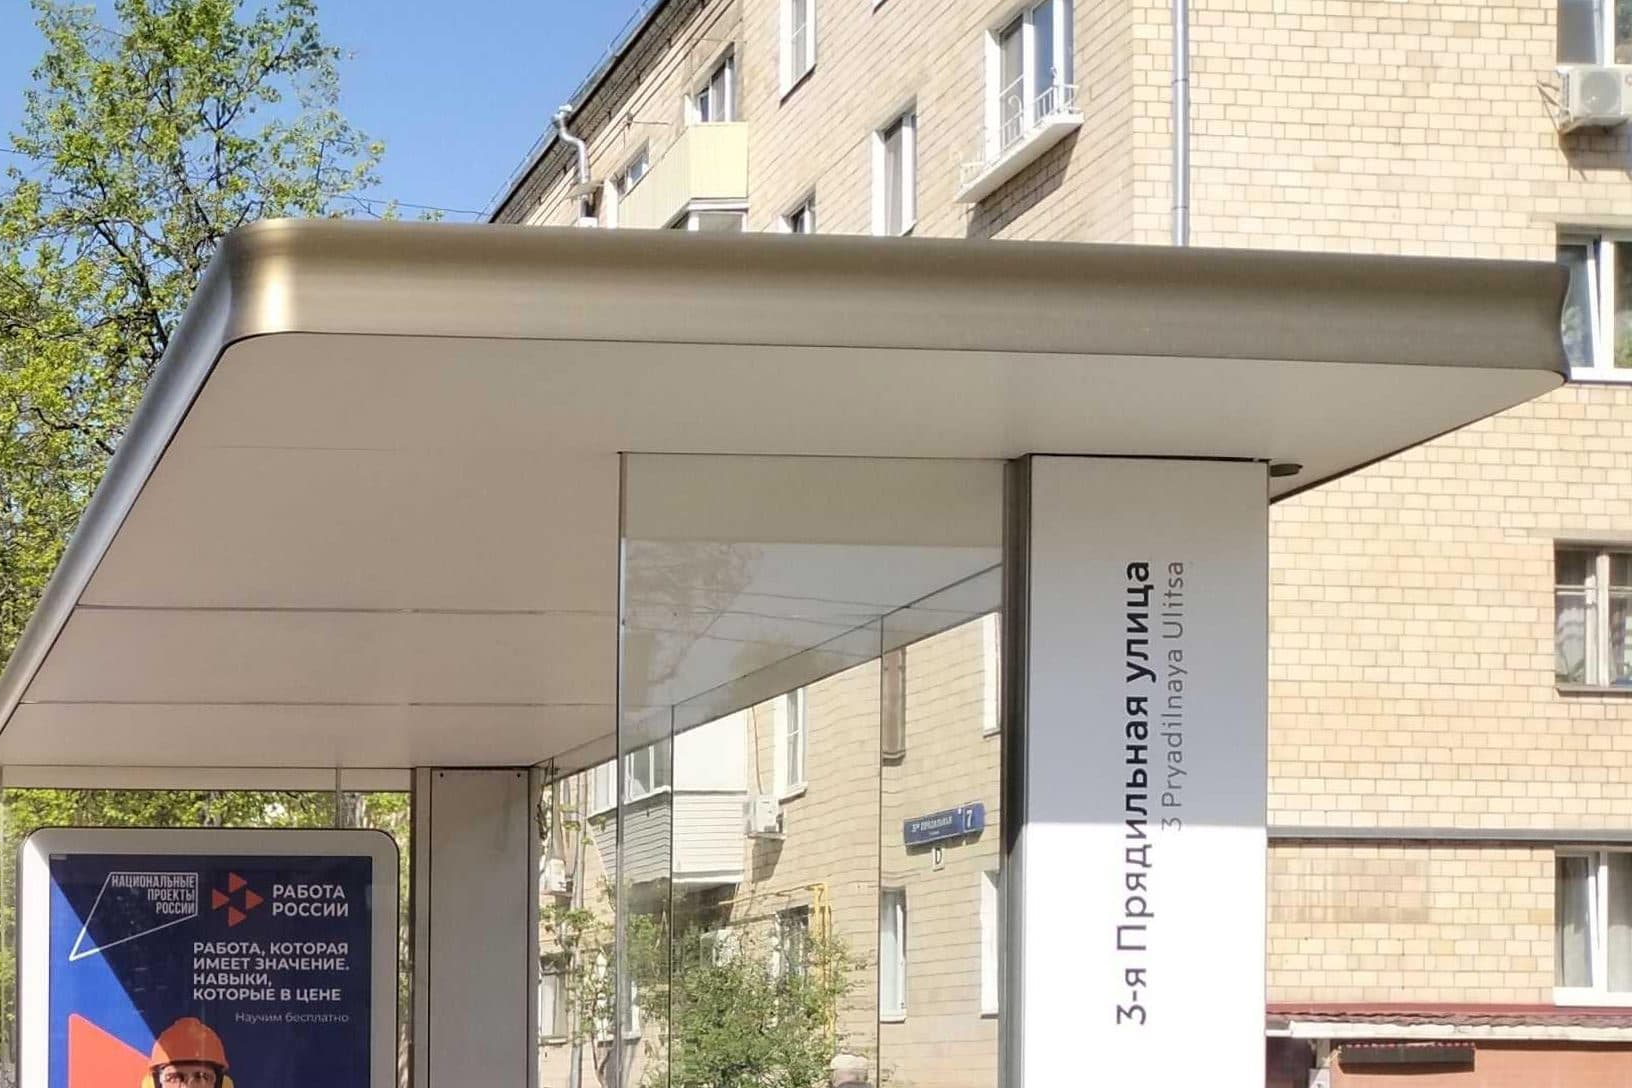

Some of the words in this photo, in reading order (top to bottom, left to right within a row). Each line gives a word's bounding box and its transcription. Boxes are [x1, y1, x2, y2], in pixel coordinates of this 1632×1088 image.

[1161, 561, 1184, 638] Ulitsa
[1126, 561, 1156, 683] улица
[1161, 648, 1188, 808] Pryadilnaya
[966, 809, 973, 828] 7
[1116, 696, 1155, 951] Прядильная
[1161, 817, 1182, 832] 3
[111, 874, 196, 888] НАЦИОНАЛЬНЫЕ
[146, 889, 196, 902] ПРОЕКТЫ
[272, 884, 346, 899] РАБОТА
[155, 901, 196, 914] РОССИИ
[272, 902, 349, 917] РОССИИ
[193, 942, 266, 957] РАБОТА,
[270, 942, 348, 956] КОТОРАЯ
[193, 957, 250, 971] ИМЕЕТ
[254, 957, 350, 971] ЗНАЧЕНИЕ.
[193, 972, 272, 988] НАВЫКИ,
[193, 988, 275, 1001] КОТОРЫЕ
[280, 988, 291, 1001] В
[295, 988, 342, 1003] ЦЕНЕ
[1116, 967, 1147, 1025] 3-я
[234, 1011, 283, 1025] Научим
[285, 1010, 350, 1024] бесплатно
